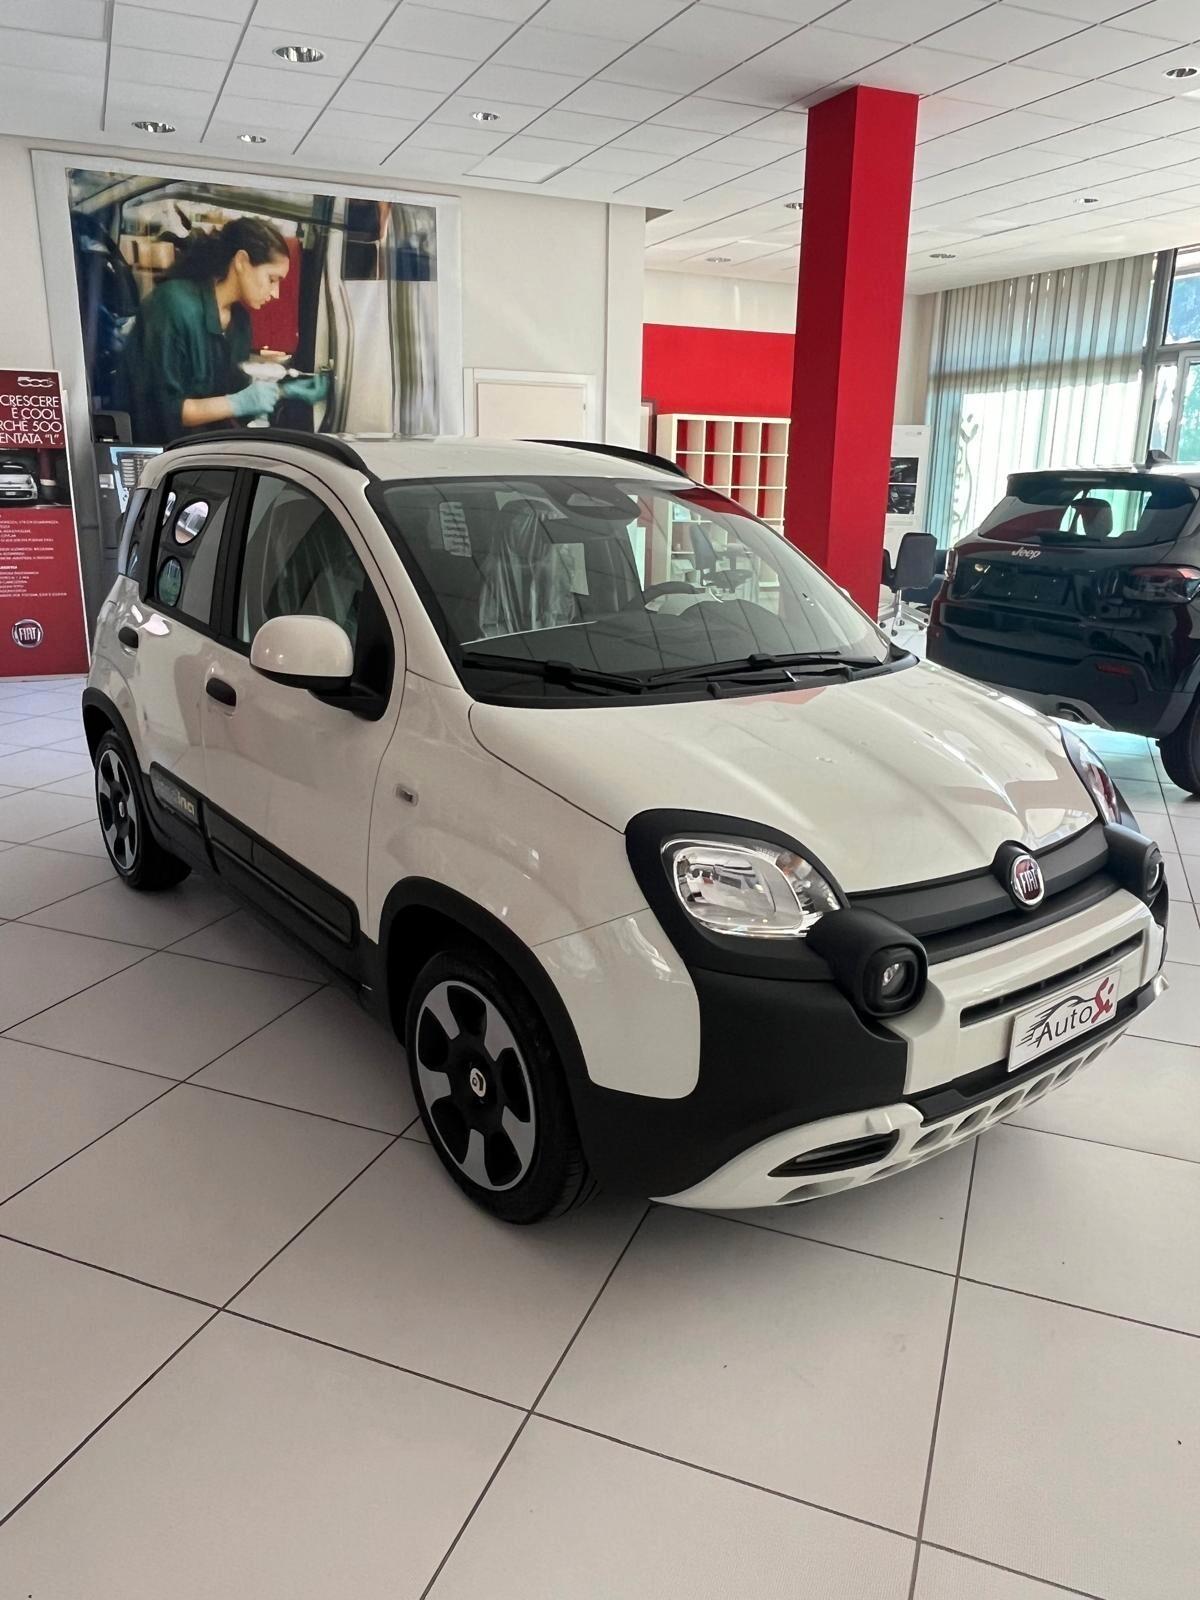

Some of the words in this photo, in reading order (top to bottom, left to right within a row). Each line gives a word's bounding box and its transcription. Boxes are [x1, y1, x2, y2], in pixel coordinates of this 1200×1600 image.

[0, 394, 59, 408] CRESCERE
[21, 408, 60, 420] COOL
[32, 420, 62, 433] 500
[1011, 546, 1041, 560] Jeep
[18, 627, 37, 641] FIAT
[1019, 868, 1039, 894] FIAT
